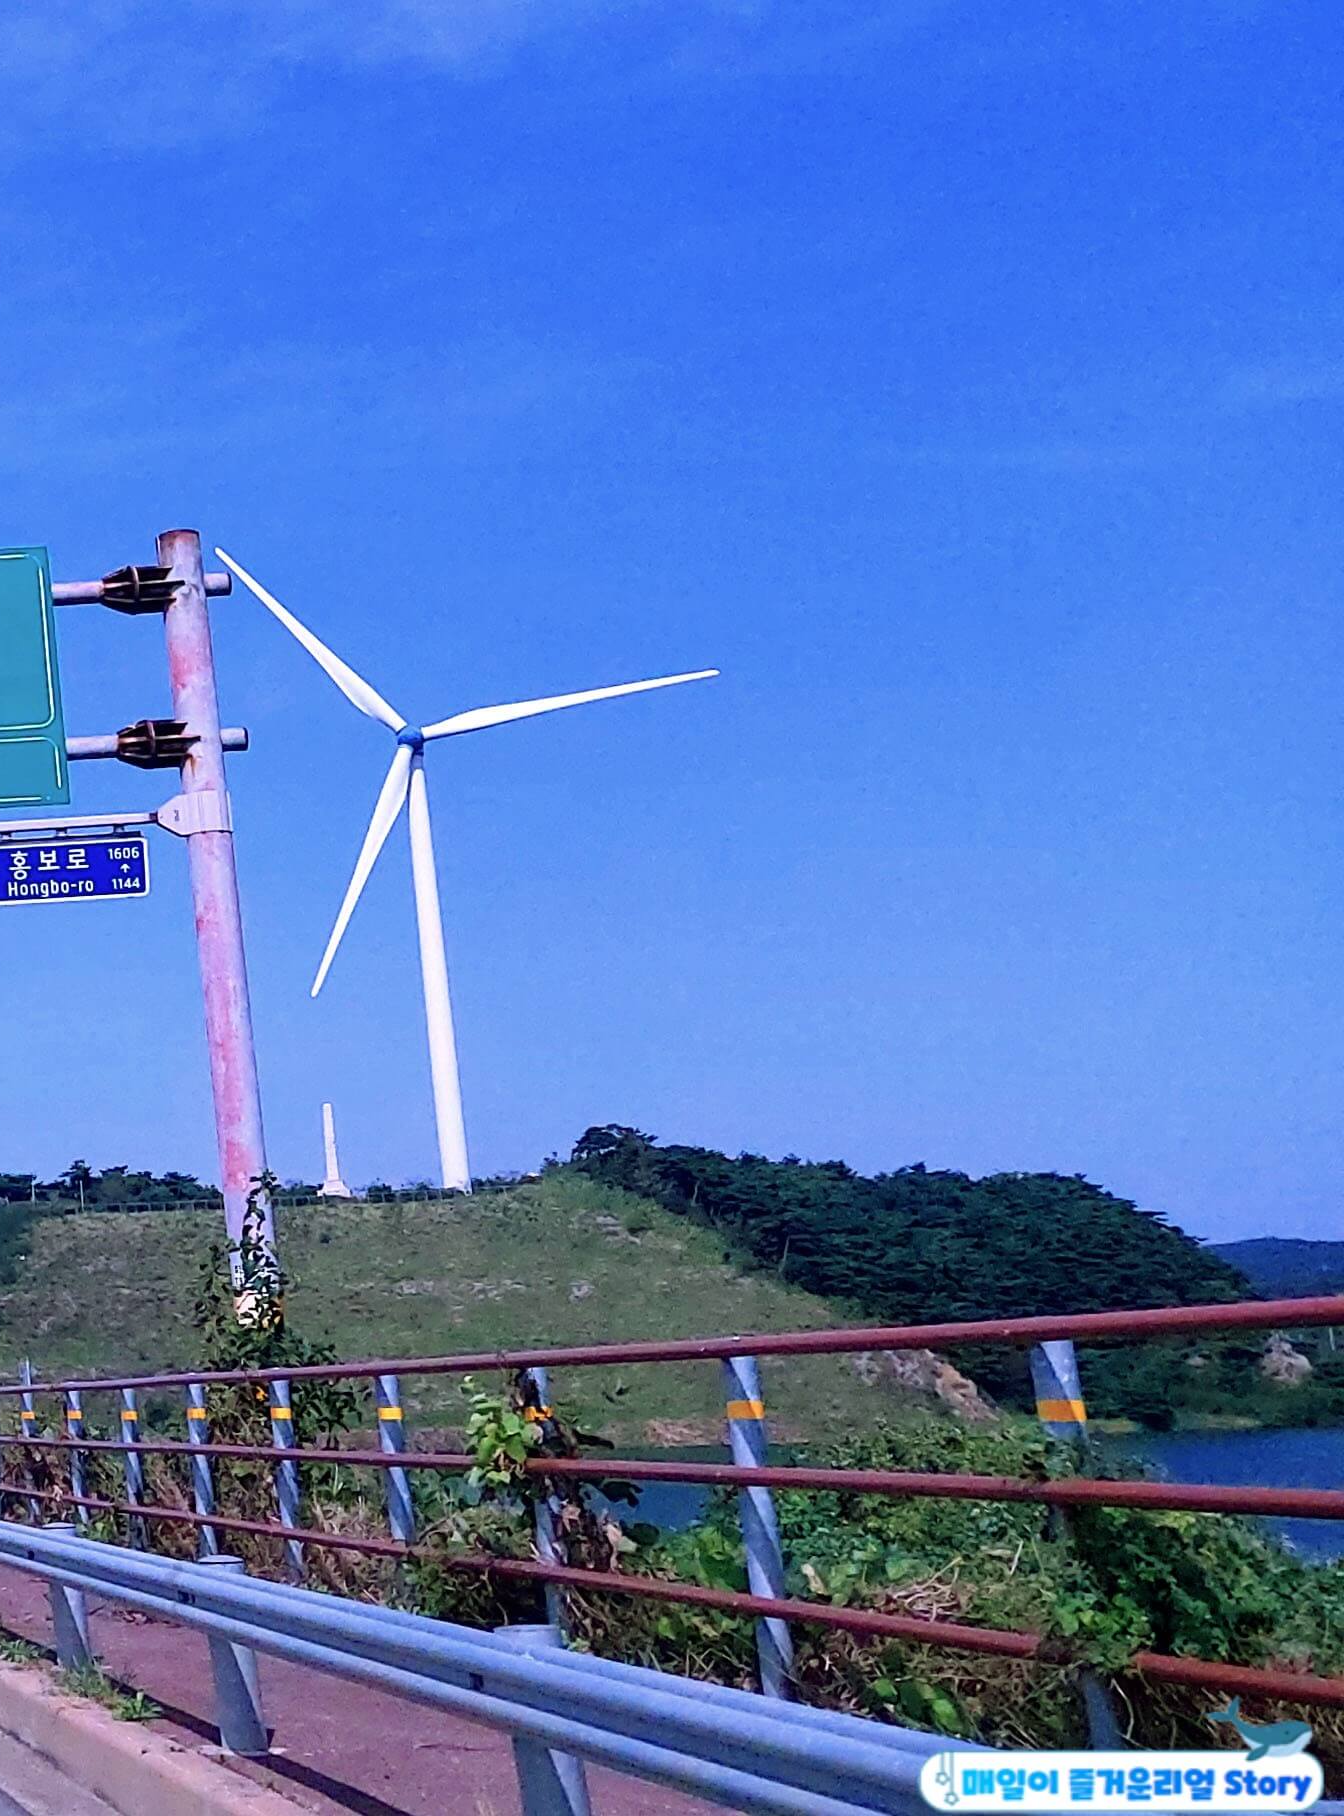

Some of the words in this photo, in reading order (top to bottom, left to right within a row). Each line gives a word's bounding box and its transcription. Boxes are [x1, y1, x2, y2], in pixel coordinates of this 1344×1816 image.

[108, 847, 140, 860] 1606
[8, 848, 90, 881] 홍보로
[7, 879, 94, 898] Hongbo-ro
[111, 877, 141, 889] 1144
